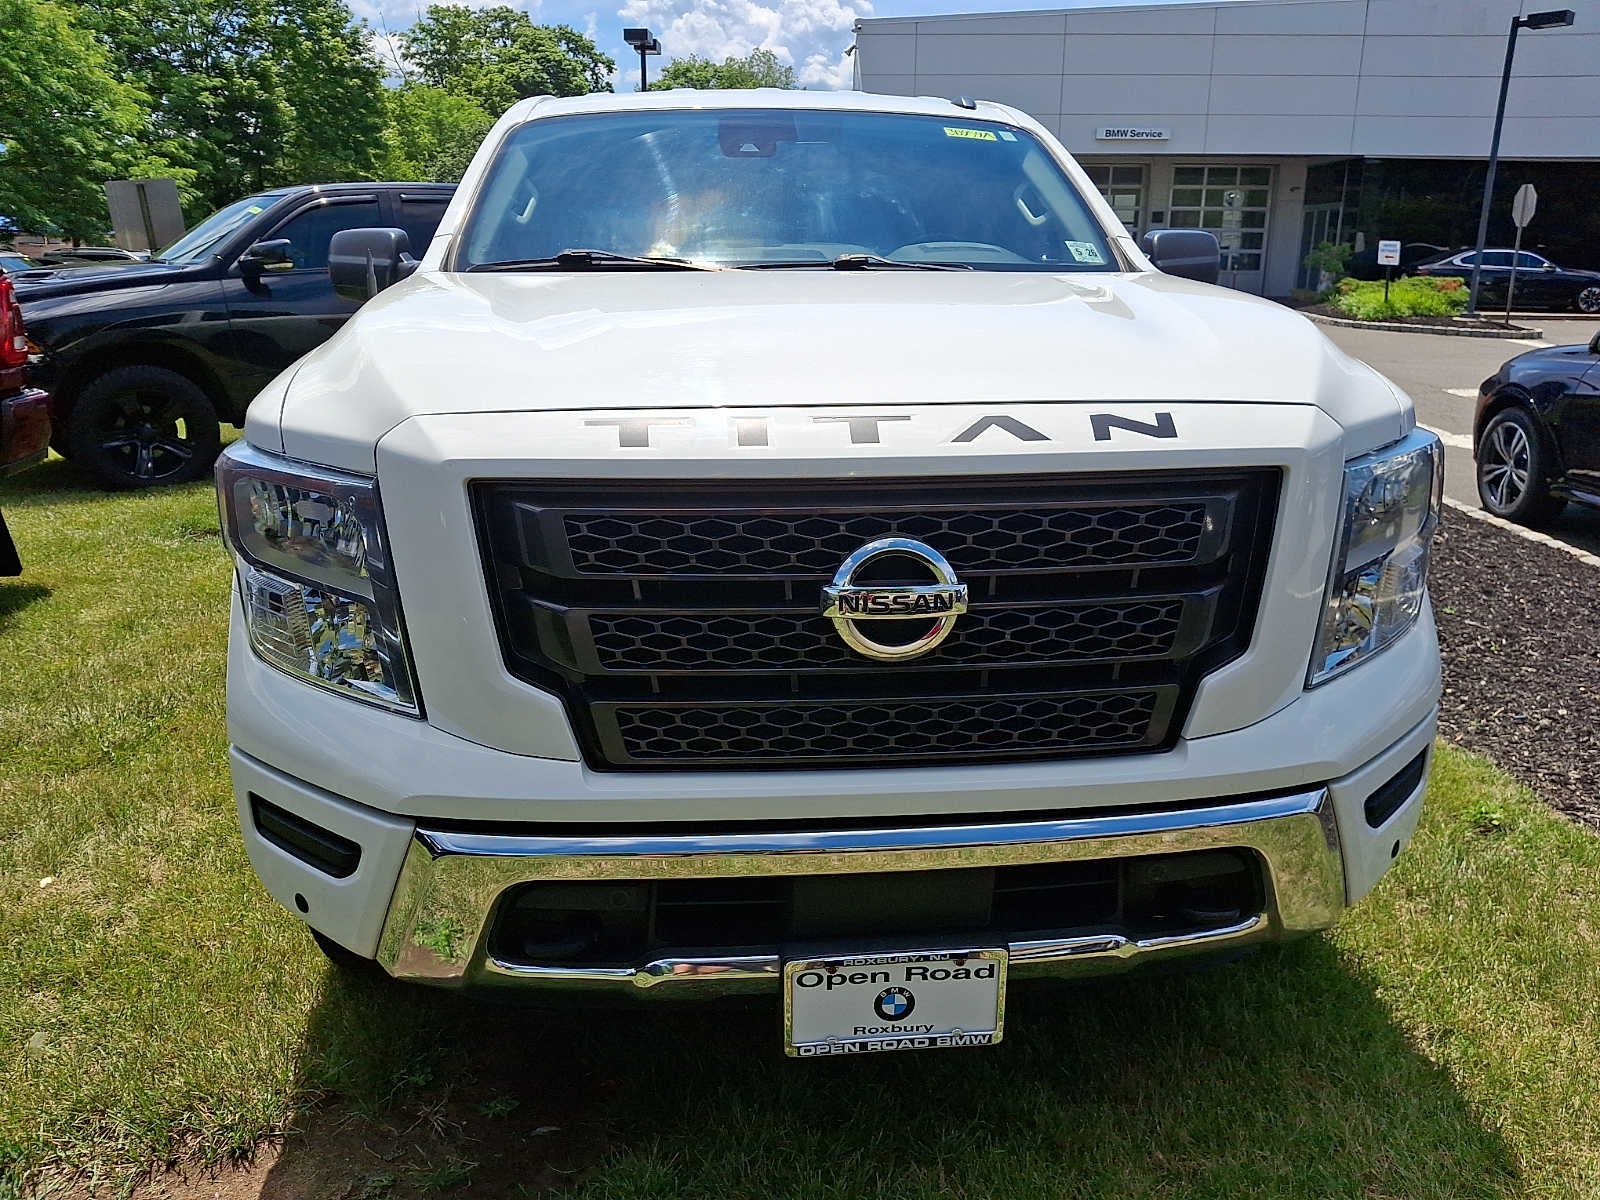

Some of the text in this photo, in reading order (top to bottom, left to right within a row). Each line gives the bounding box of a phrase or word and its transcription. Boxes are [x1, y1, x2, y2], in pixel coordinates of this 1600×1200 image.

[1104, 129, 1163, 138] BMW Service
[584, 412, 1177, 448] TITAN
[838, 592, 954, 615] NISSAN
[929, 953, 950, 961] NJ
[796, 963, 996, 990] Open Road
[880, 987, 912, 999] BMW
[853, 1023, 936, 1036] Roxbury
[799, 1034, 991, 1057] OPEN ROAD BMW
